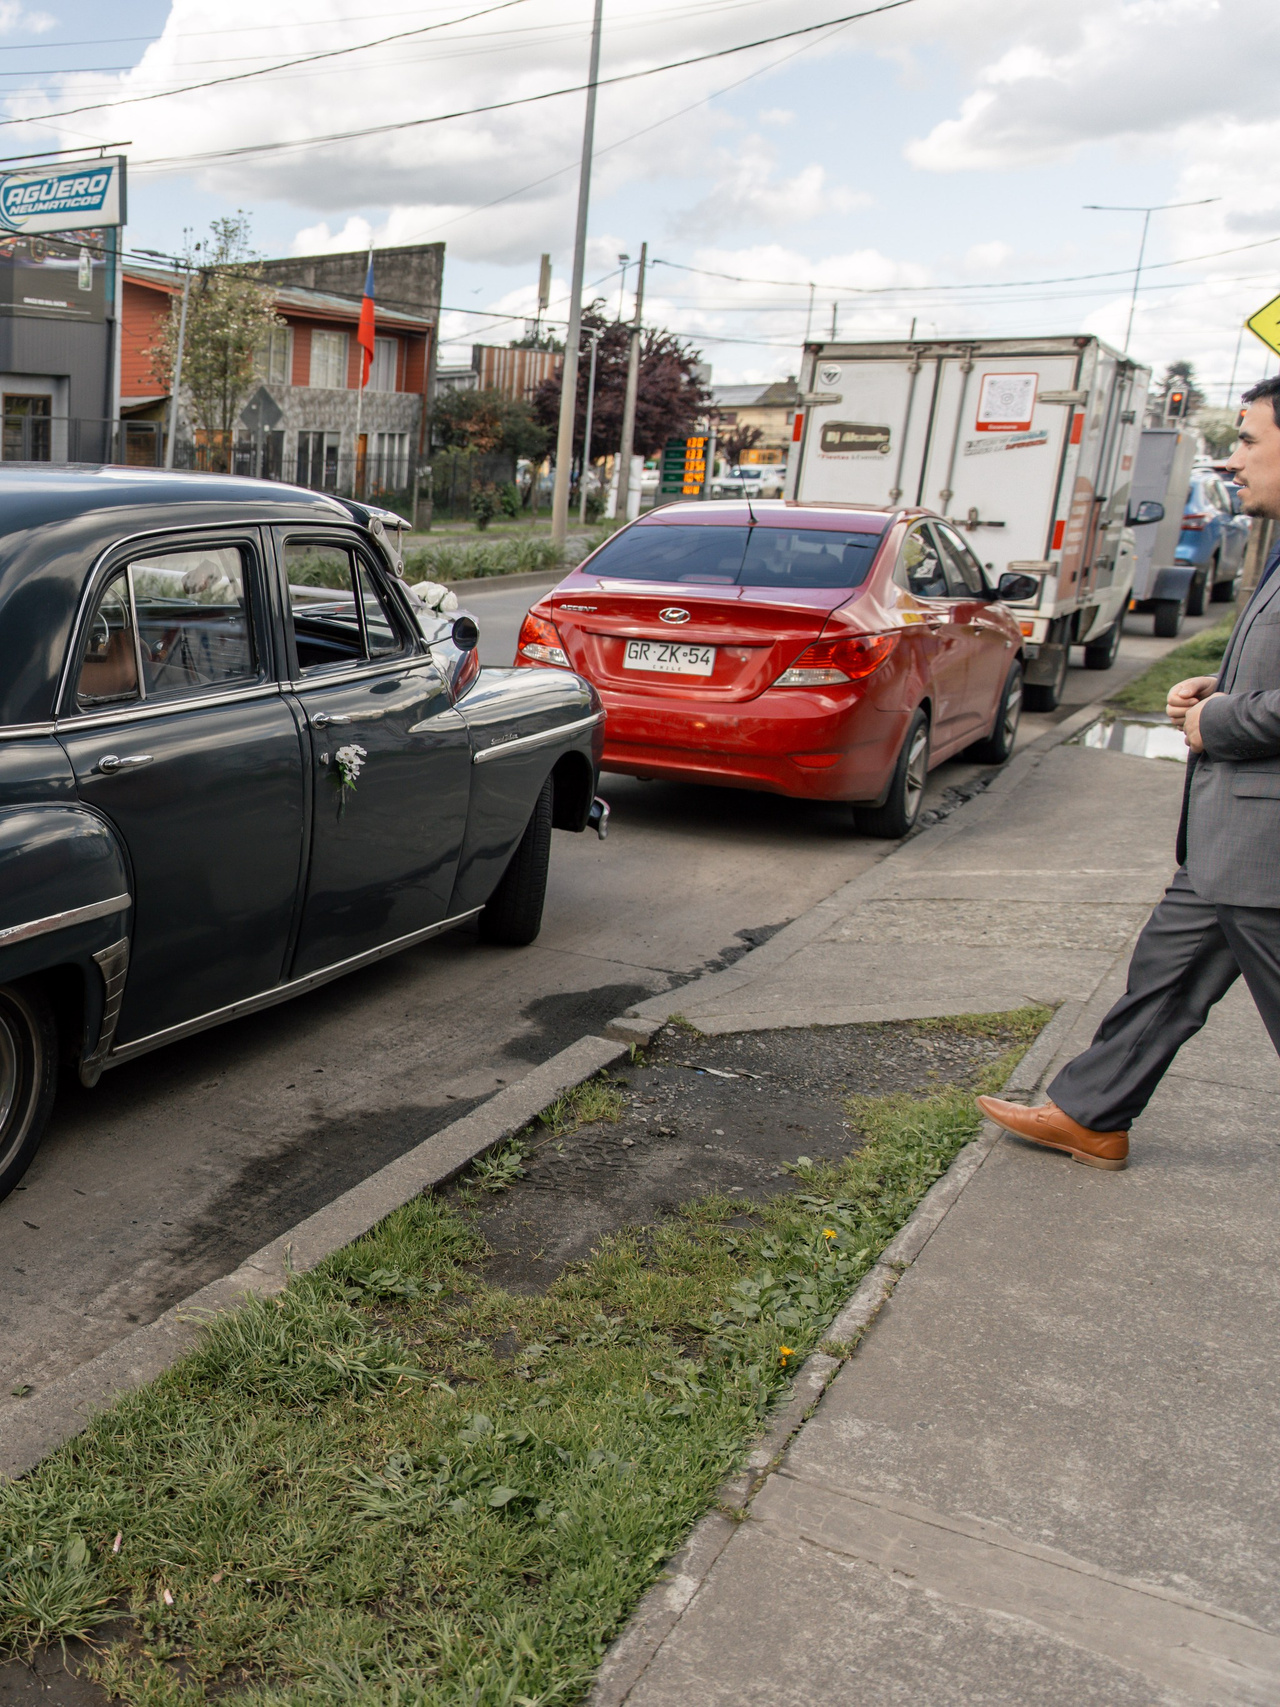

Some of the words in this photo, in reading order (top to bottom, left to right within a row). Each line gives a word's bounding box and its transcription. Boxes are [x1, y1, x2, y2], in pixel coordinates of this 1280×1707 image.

[6, 174, 108, 206] AGÜERO
[9, 195, 102, 215] NEUMATICOS
[559, 604, 597, 612] ACCENT
